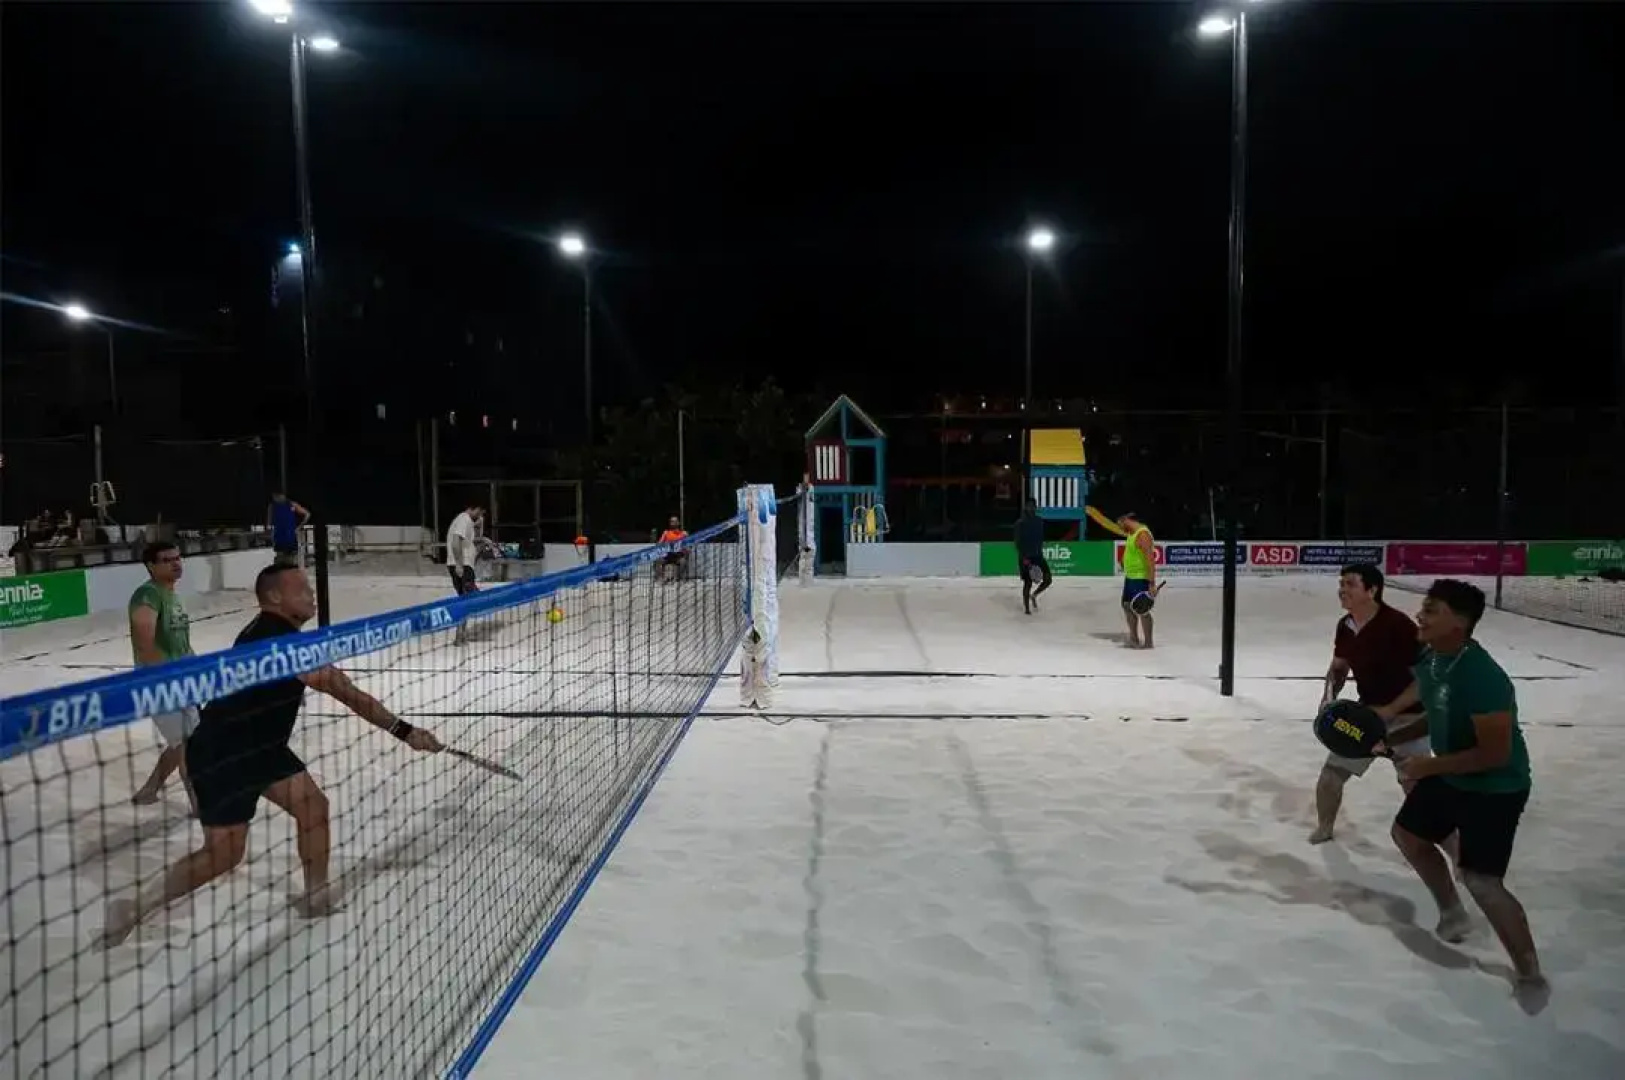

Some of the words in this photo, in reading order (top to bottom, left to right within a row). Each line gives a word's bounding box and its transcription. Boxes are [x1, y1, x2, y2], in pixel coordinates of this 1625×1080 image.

[1042, 544, 1071, 560] nia
[1255, 548, 1295, 562] ASD
[0, 580, 44, 605] ennia
[48, 692, 104, 735] BTA
[431, 606, 452, 627] BTA
